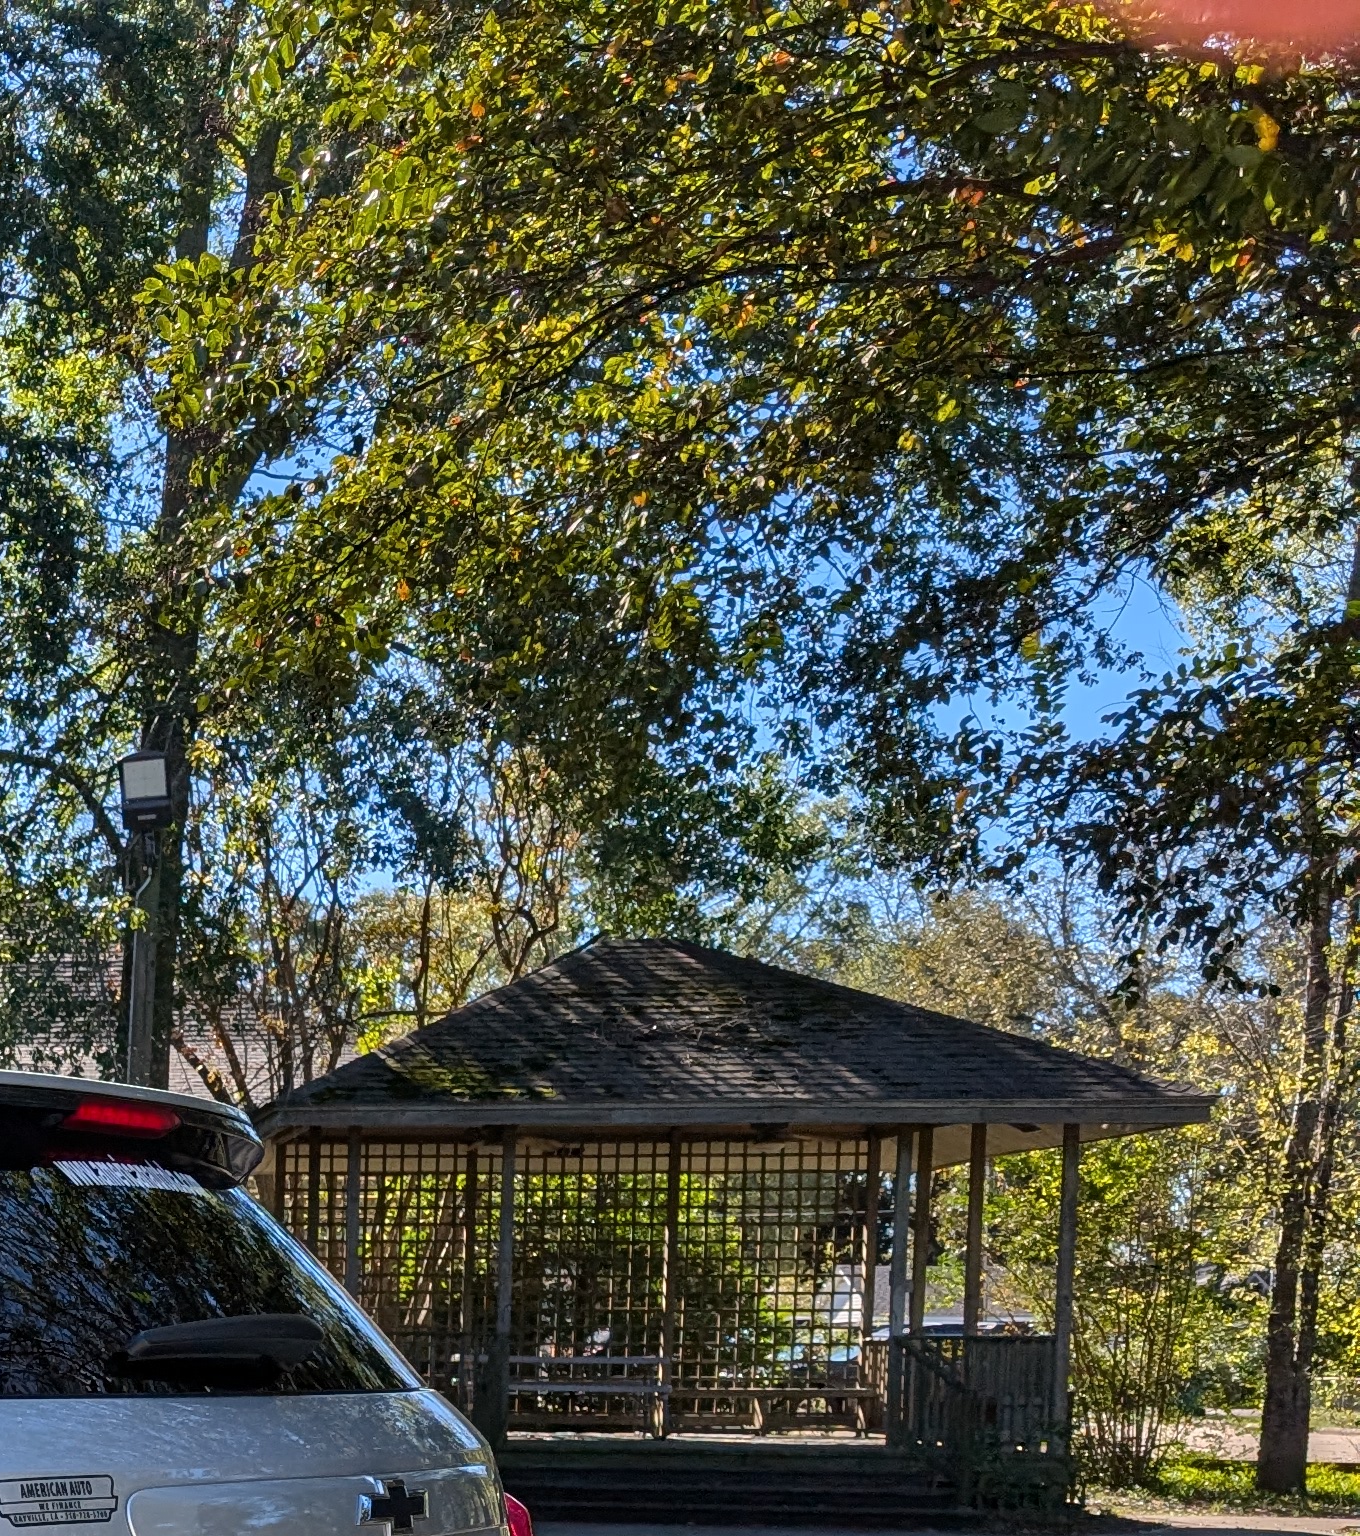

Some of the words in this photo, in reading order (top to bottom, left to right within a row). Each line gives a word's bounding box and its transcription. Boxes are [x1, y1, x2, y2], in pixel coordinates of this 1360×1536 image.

[20, 1481, 68, 1499] AMERICAN
[69, 1480, 93, 1496] AUTO
[38, 1503, 50, 1511] WE
[51, 1501, 82, 1510] FINANCE
